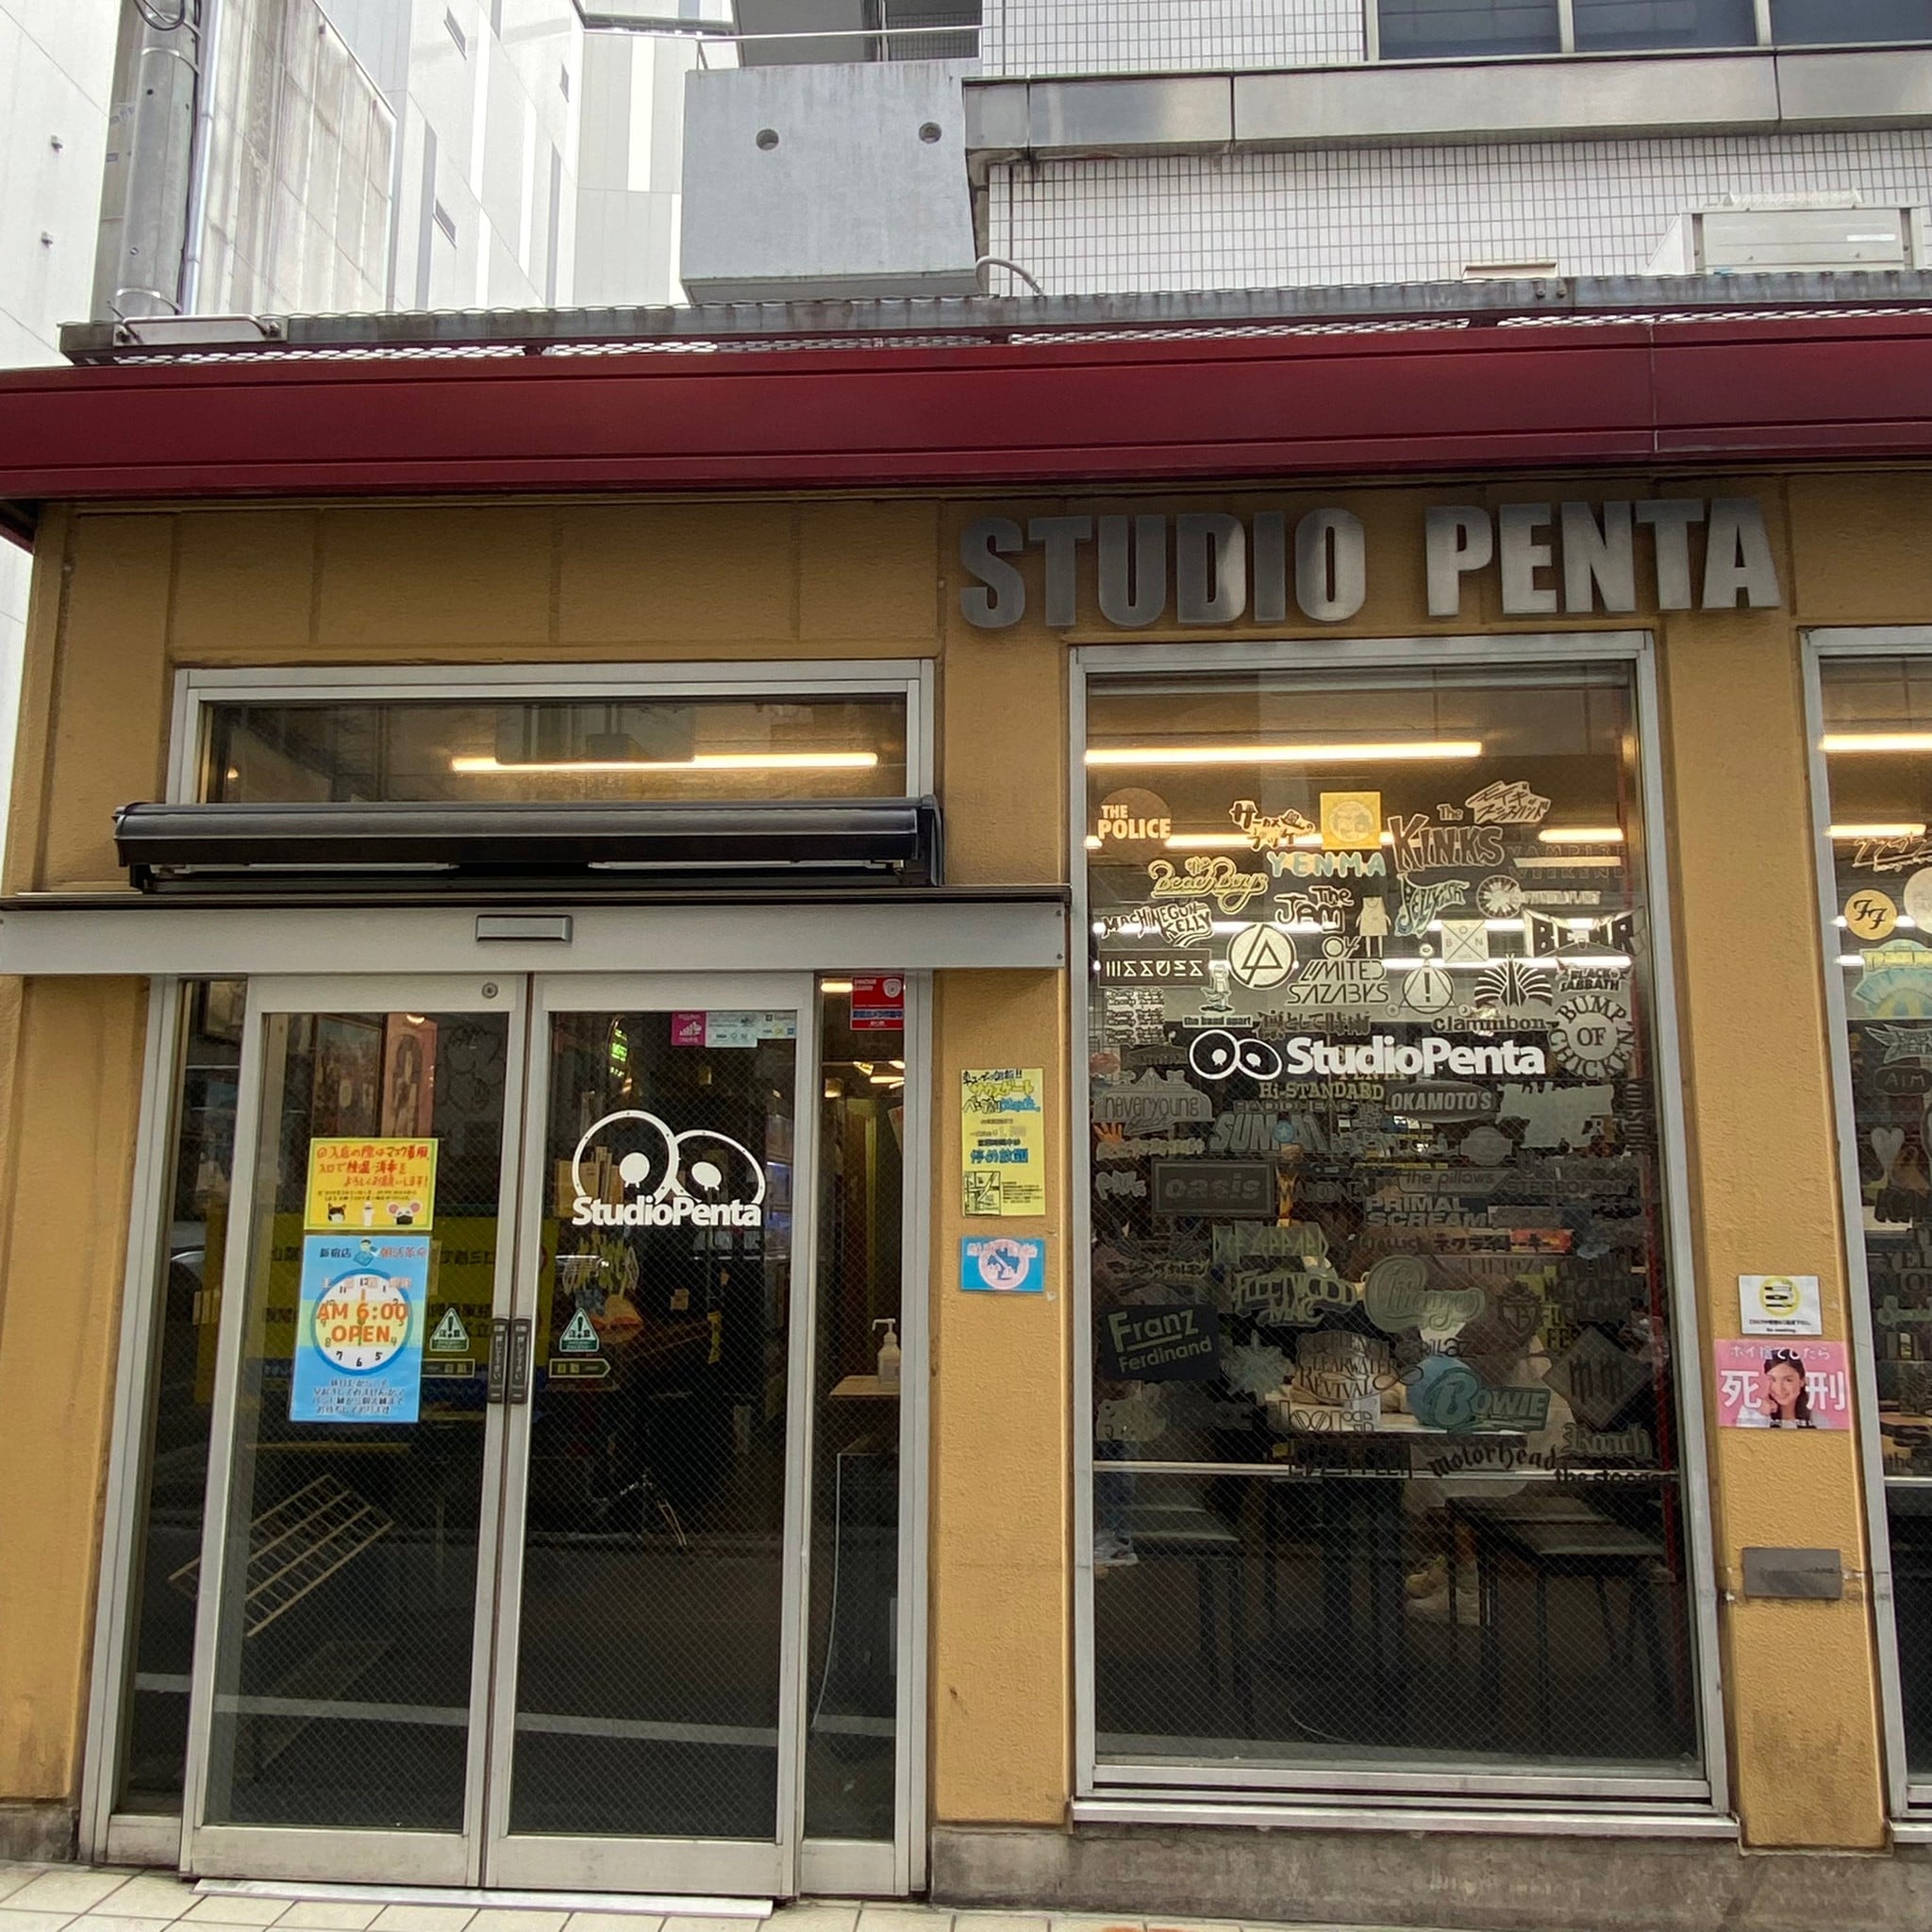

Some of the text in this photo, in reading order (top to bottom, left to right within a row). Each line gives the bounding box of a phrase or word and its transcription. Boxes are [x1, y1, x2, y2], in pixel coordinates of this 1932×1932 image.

[960, 497, 1781, 628] STUDIO PENTA
[1102, 805, 1127, 819] THE
[1438, 805, 1462, 820] The
[1098, 818, 1171, 840] POLICE
[1388, 814, 1505, 873] KINKS
[1267, 852, 1386, 877] YENMA
[1161, 912, 1212, 941] KELLY
[1300, 959, 1387, 981] LIMITED
[1561, 992, 1627, 1024] BUMP
[1576, 1027, 1607, 1046] OF
[1287, 1036, 1546, 1075] StudioPenta
[1548, 1021, 1636, 1081] CHICKEN
[1259, 1081, 1385, 1101] Hi-STANDARD
[1391, 1091, 1494, 1111] OKAMOTO'S
[1105, 1096, 1199, 1120] neveryoung
[1210, 1112, 1281, 1151] SUM
[1165, 1173, 1262, 1200] oasis
[572, 1195, 762, 1227] StudioPenta
[1367, 1196, 1469, 1211] PRIMAL
[1367, 1212, 1488, 1227] SCREAM
[317, 1302, 408, 1321] AM 6:00
[331, 1324, 391, 1343] OPEN
[1108, 1308, 1199, 1353] Franz
[1119, 1335, 1213, 1374] Ferdinand
[1426, 1370, 1547, 1425] BOWIE
